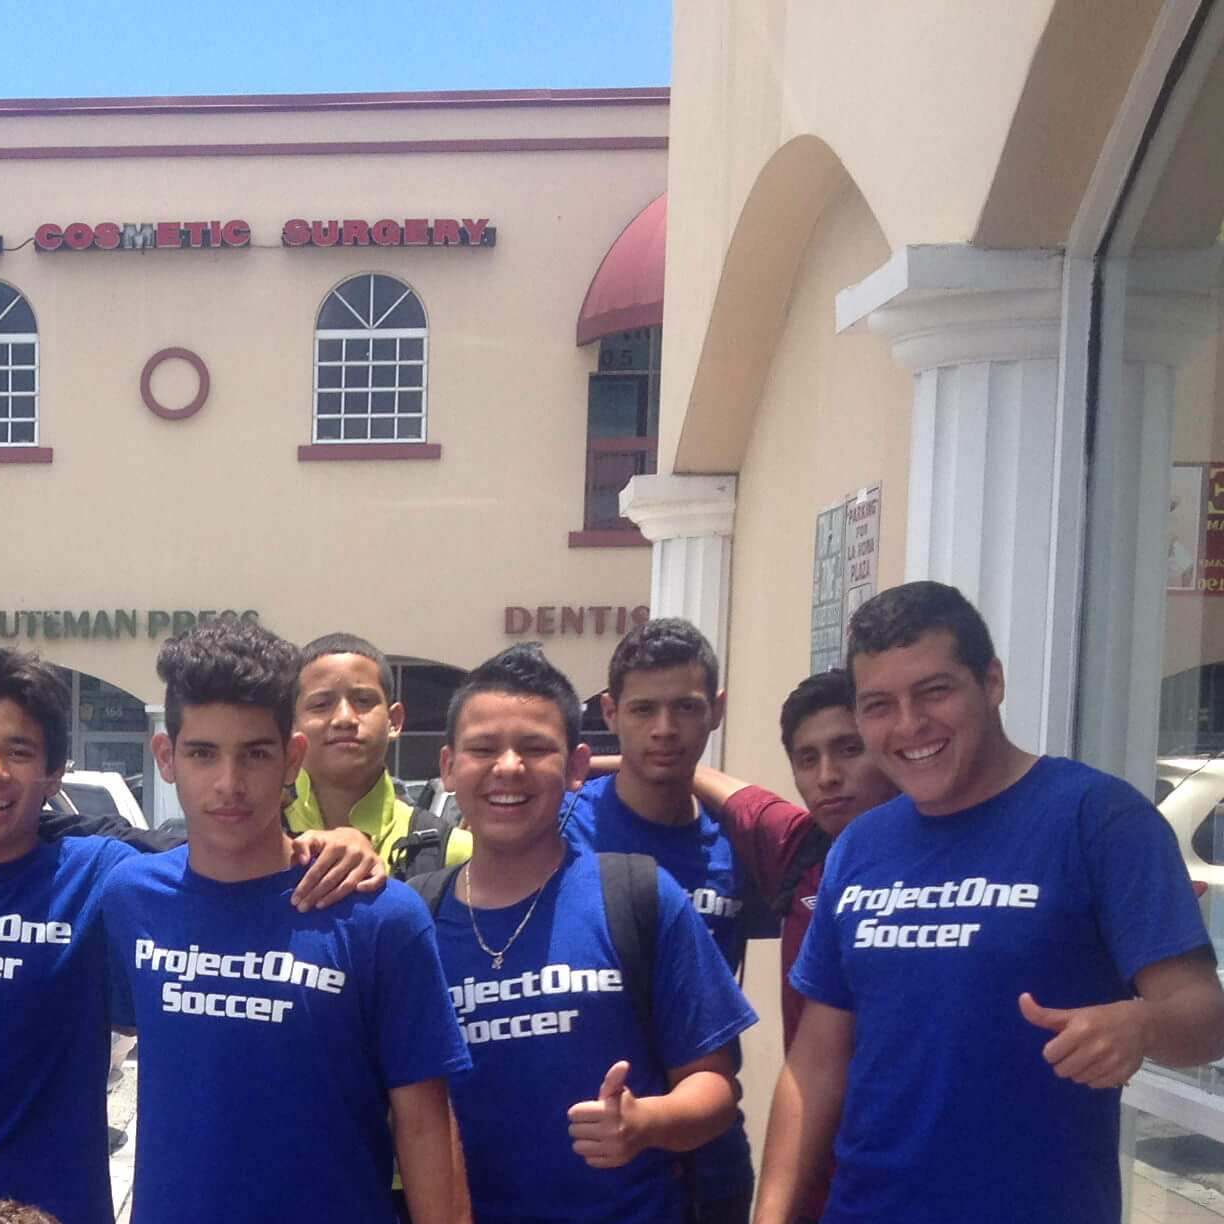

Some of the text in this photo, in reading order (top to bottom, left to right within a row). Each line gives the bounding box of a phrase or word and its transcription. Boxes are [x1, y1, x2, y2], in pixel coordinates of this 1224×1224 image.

[34, 219, 251, 250] COSMETIC
[281, 217, 491, 247] SURGERY
[835, 876, 1040, 916] ProjectOne
[853, 917, 982, 949] Soccer
[135, 938, 346, 994] ProjectOne
[161, 981, 294, 1023] Soccer
[447, 963, 625, 1015] ojectOne
